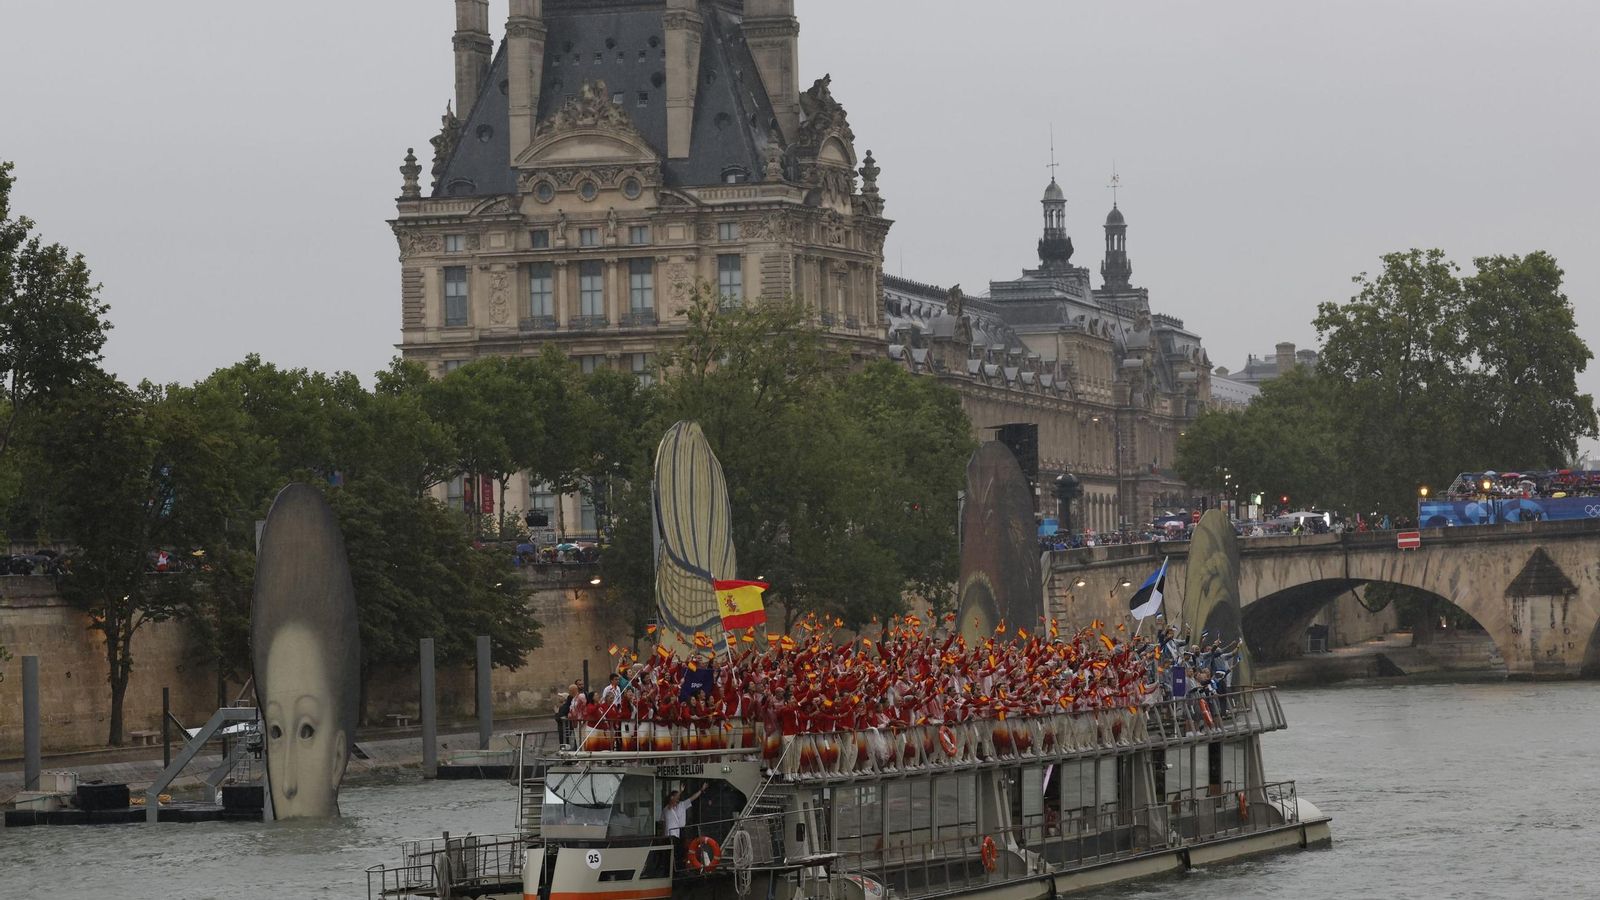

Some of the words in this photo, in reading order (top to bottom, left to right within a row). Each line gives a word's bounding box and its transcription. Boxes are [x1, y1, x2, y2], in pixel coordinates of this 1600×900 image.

[657, 765, 679, 775] PIERRE
[681, 763, 704, 775] BELLON
[588, 853, 600, 864] 25
